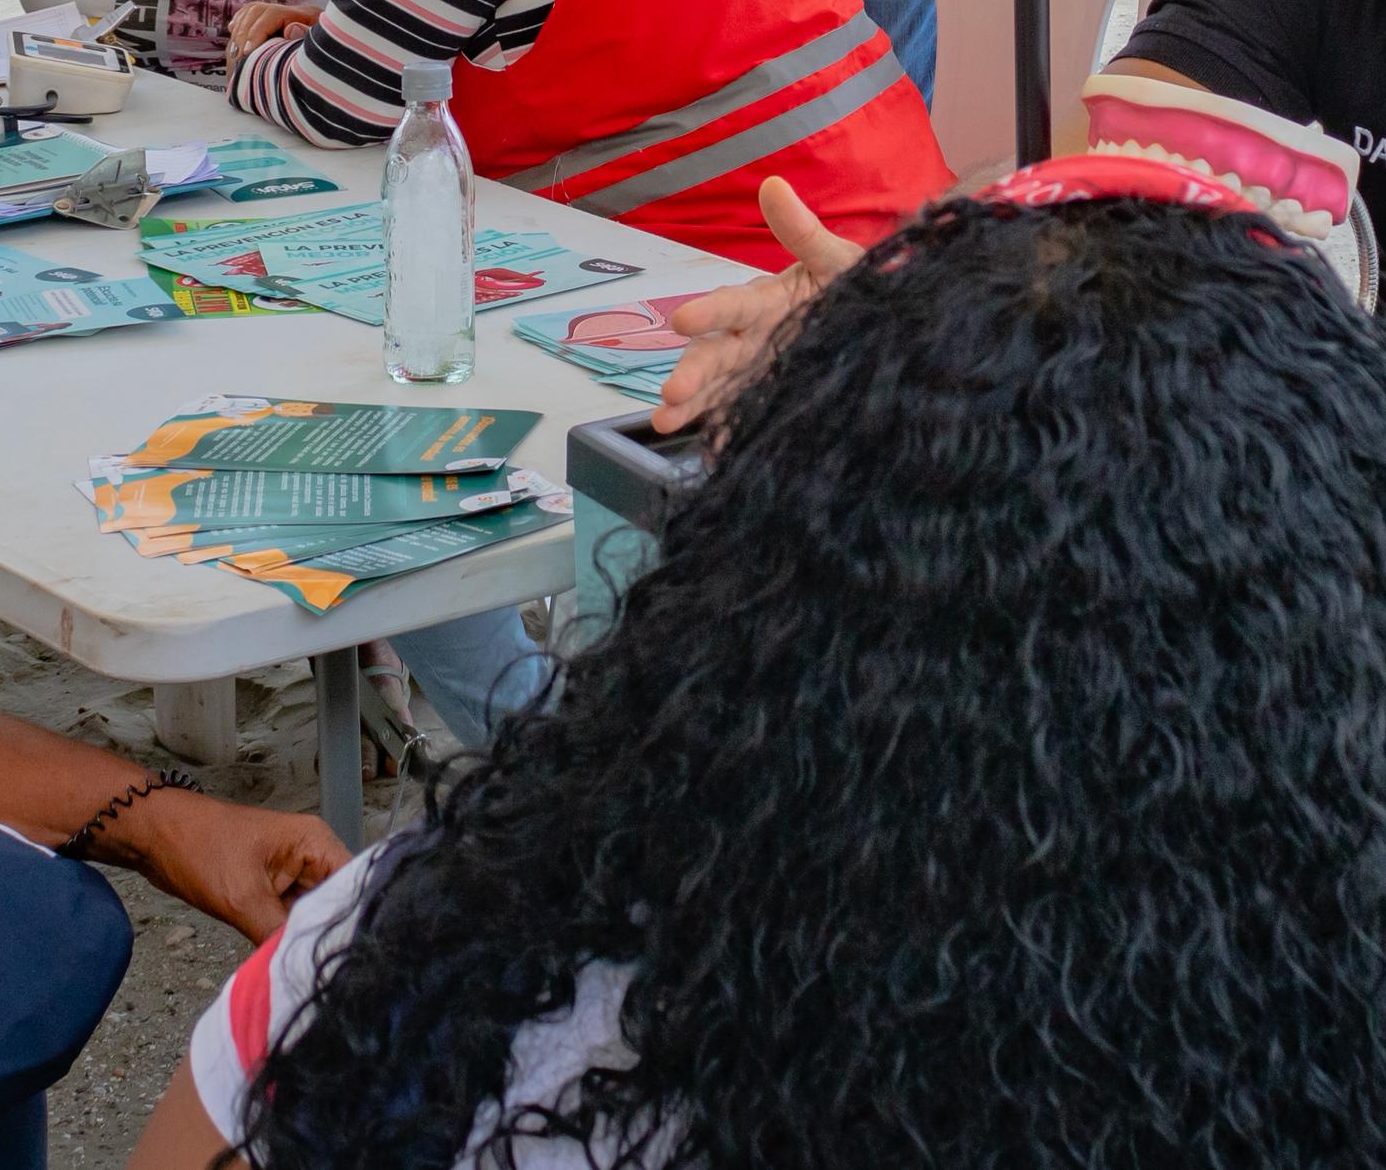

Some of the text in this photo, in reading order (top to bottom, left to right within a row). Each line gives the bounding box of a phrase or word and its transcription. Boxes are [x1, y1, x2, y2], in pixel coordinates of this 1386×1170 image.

[164, 212, 370, 258] LA PREVENCIÓN ES LA
[491, 240, 518, 249] LA
[318, 281, 349, 290] LA
